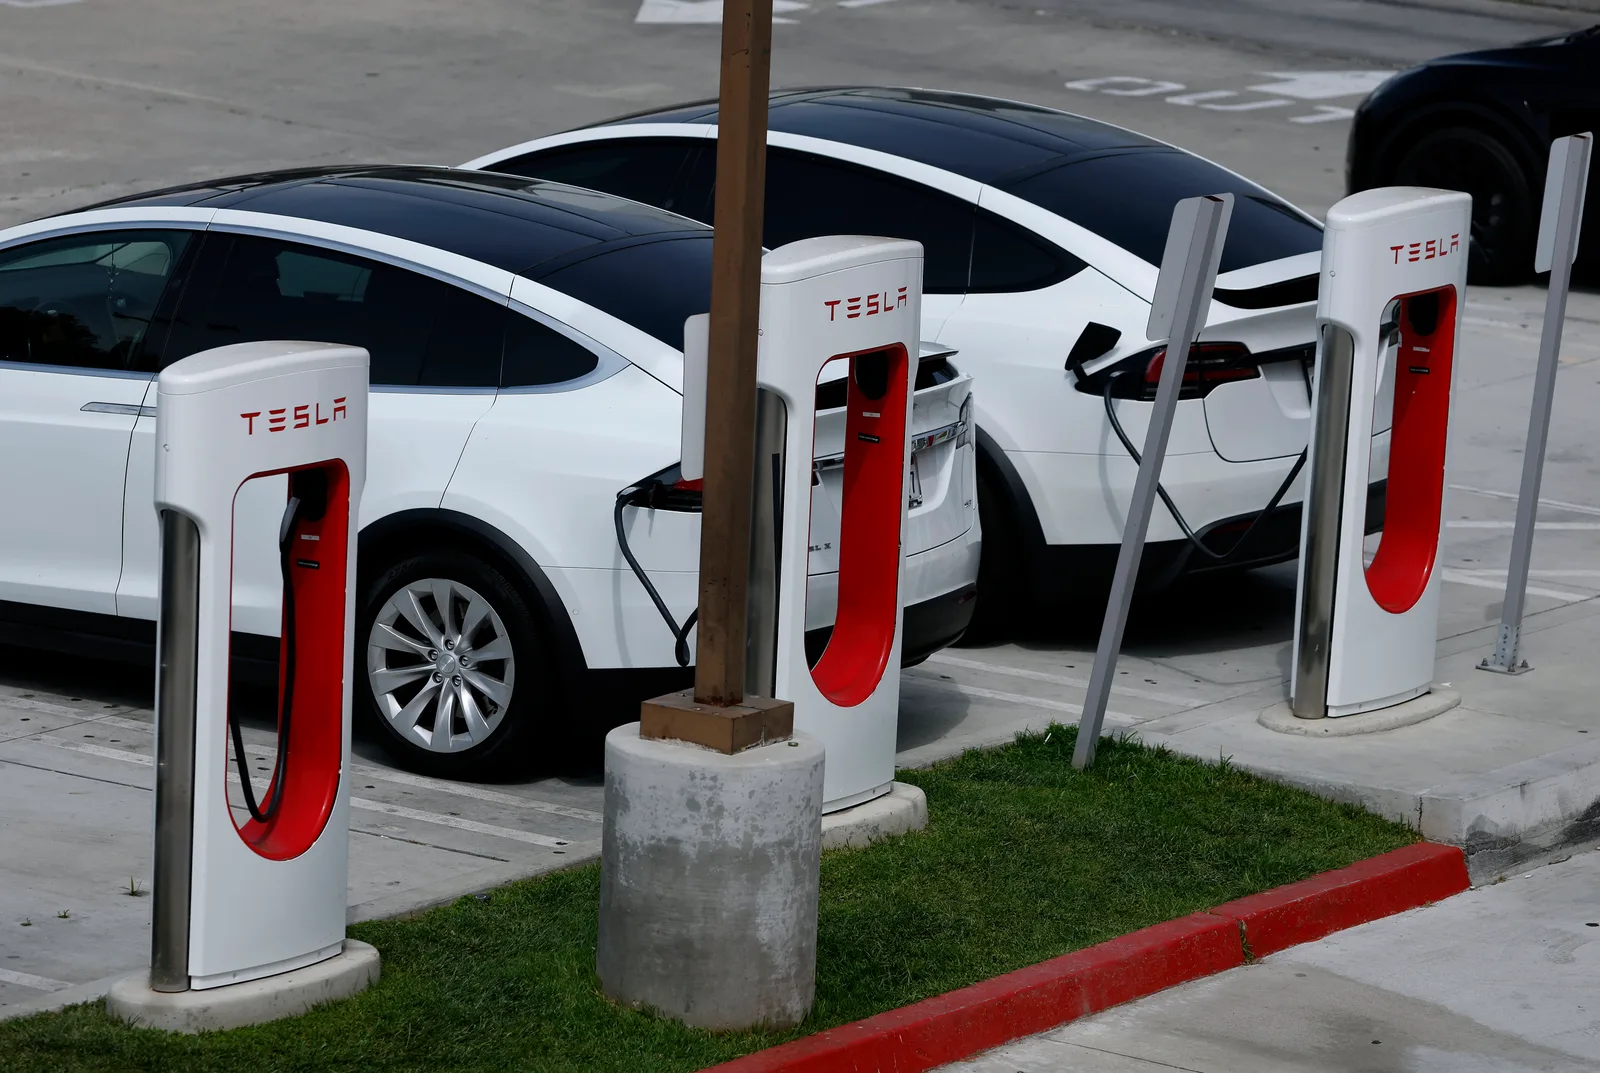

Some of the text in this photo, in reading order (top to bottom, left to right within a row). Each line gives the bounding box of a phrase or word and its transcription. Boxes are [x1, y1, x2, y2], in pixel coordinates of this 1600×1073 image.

[1390, 233, 1459, 264] TESLA
[824, 286, 907, 321] TESLA
[240, 396, 346, 435] TESLA
